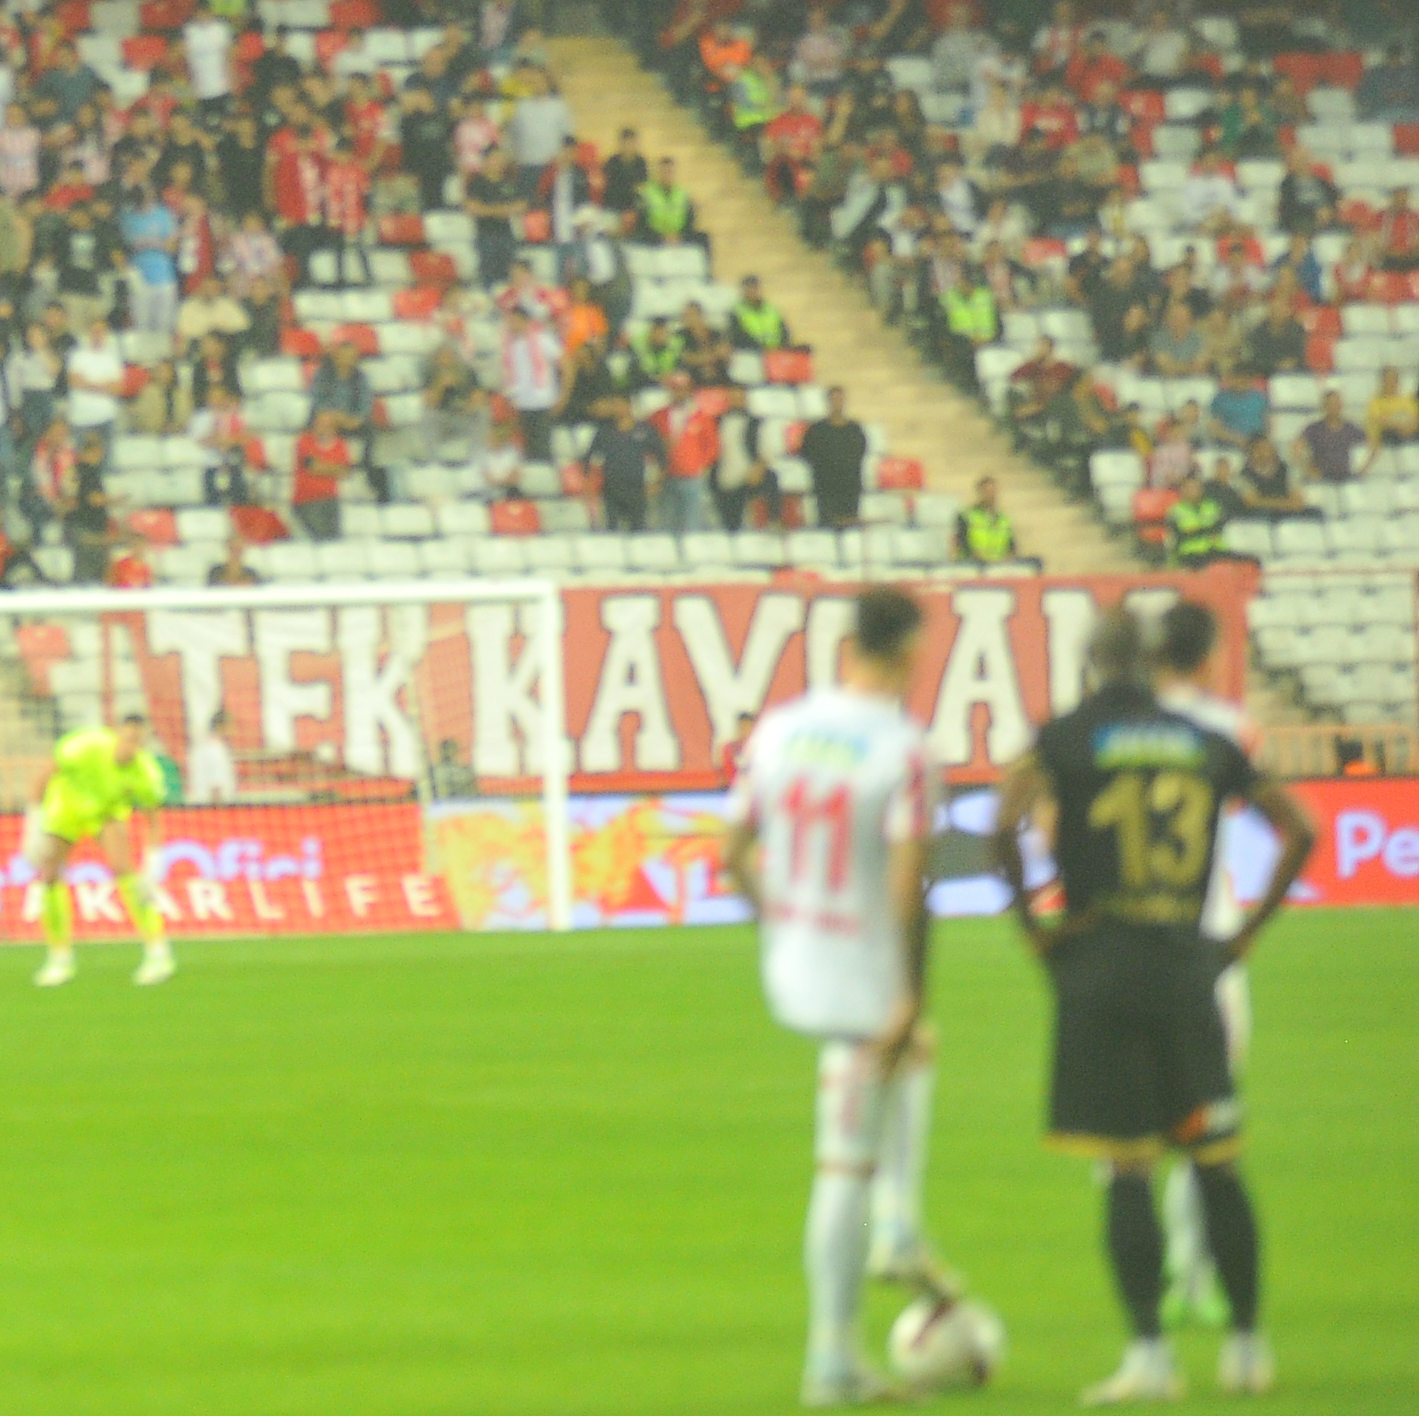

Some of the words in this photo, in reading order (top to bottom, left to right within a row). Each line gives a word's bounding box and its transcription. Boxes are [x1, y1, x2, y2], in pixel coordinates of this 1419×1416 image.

[145, 602, 430, 778] TEK
[781, 774, 852, 894] 11
[1088, 771, 1213, 888] 13
